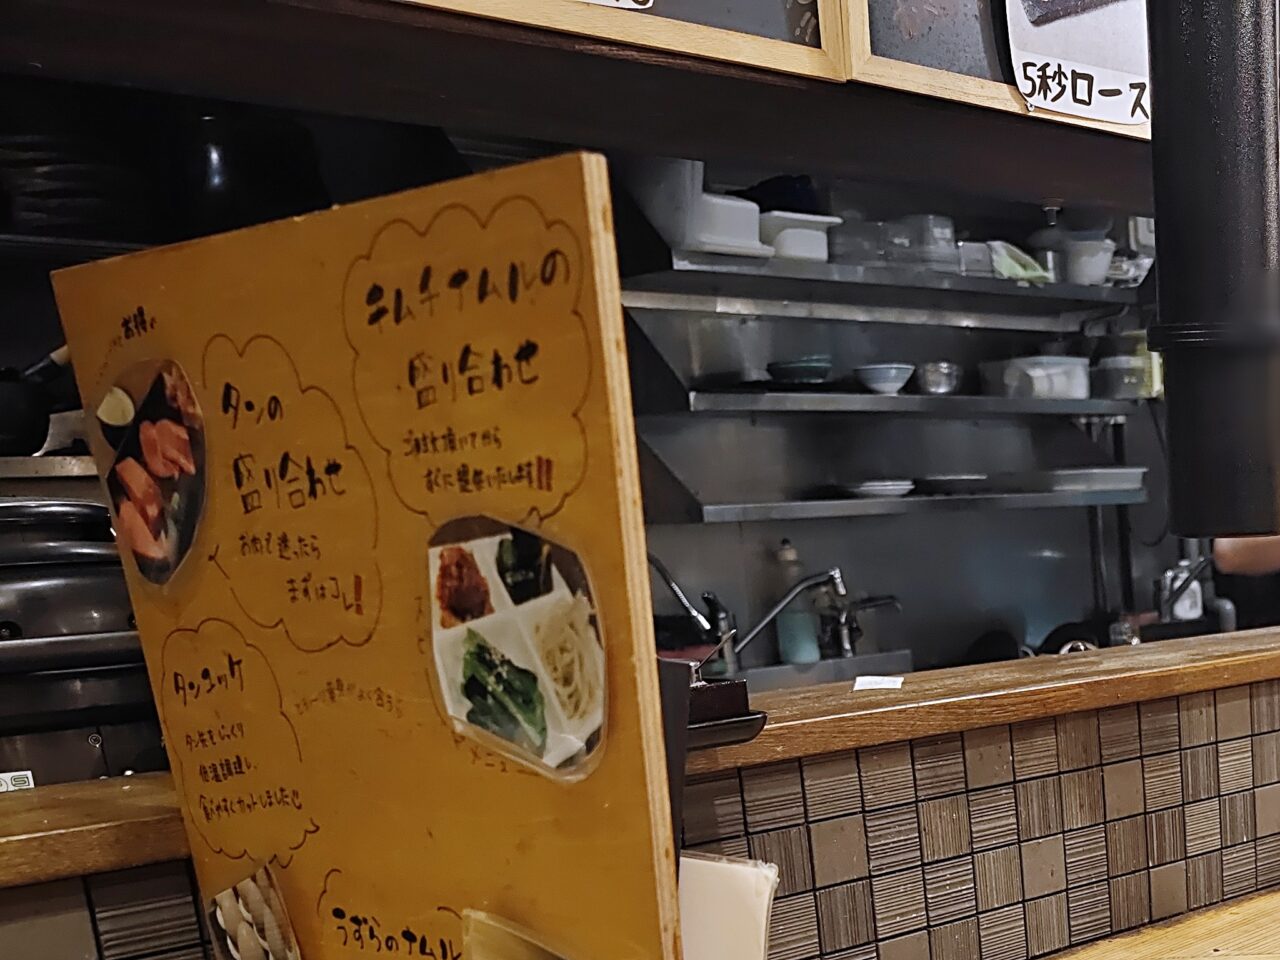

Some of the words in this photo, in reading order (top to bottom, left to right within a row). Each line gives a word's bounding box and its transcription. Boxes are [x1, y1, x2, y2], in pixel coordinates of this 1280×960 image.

[1022, 60, 1150, 121] 5秒ロース
[407, 339, 540, 410] 盛り合わせ
[222, 382, 283, 430] タンの
[233, 451, 346, 515] 盛り合わせ
